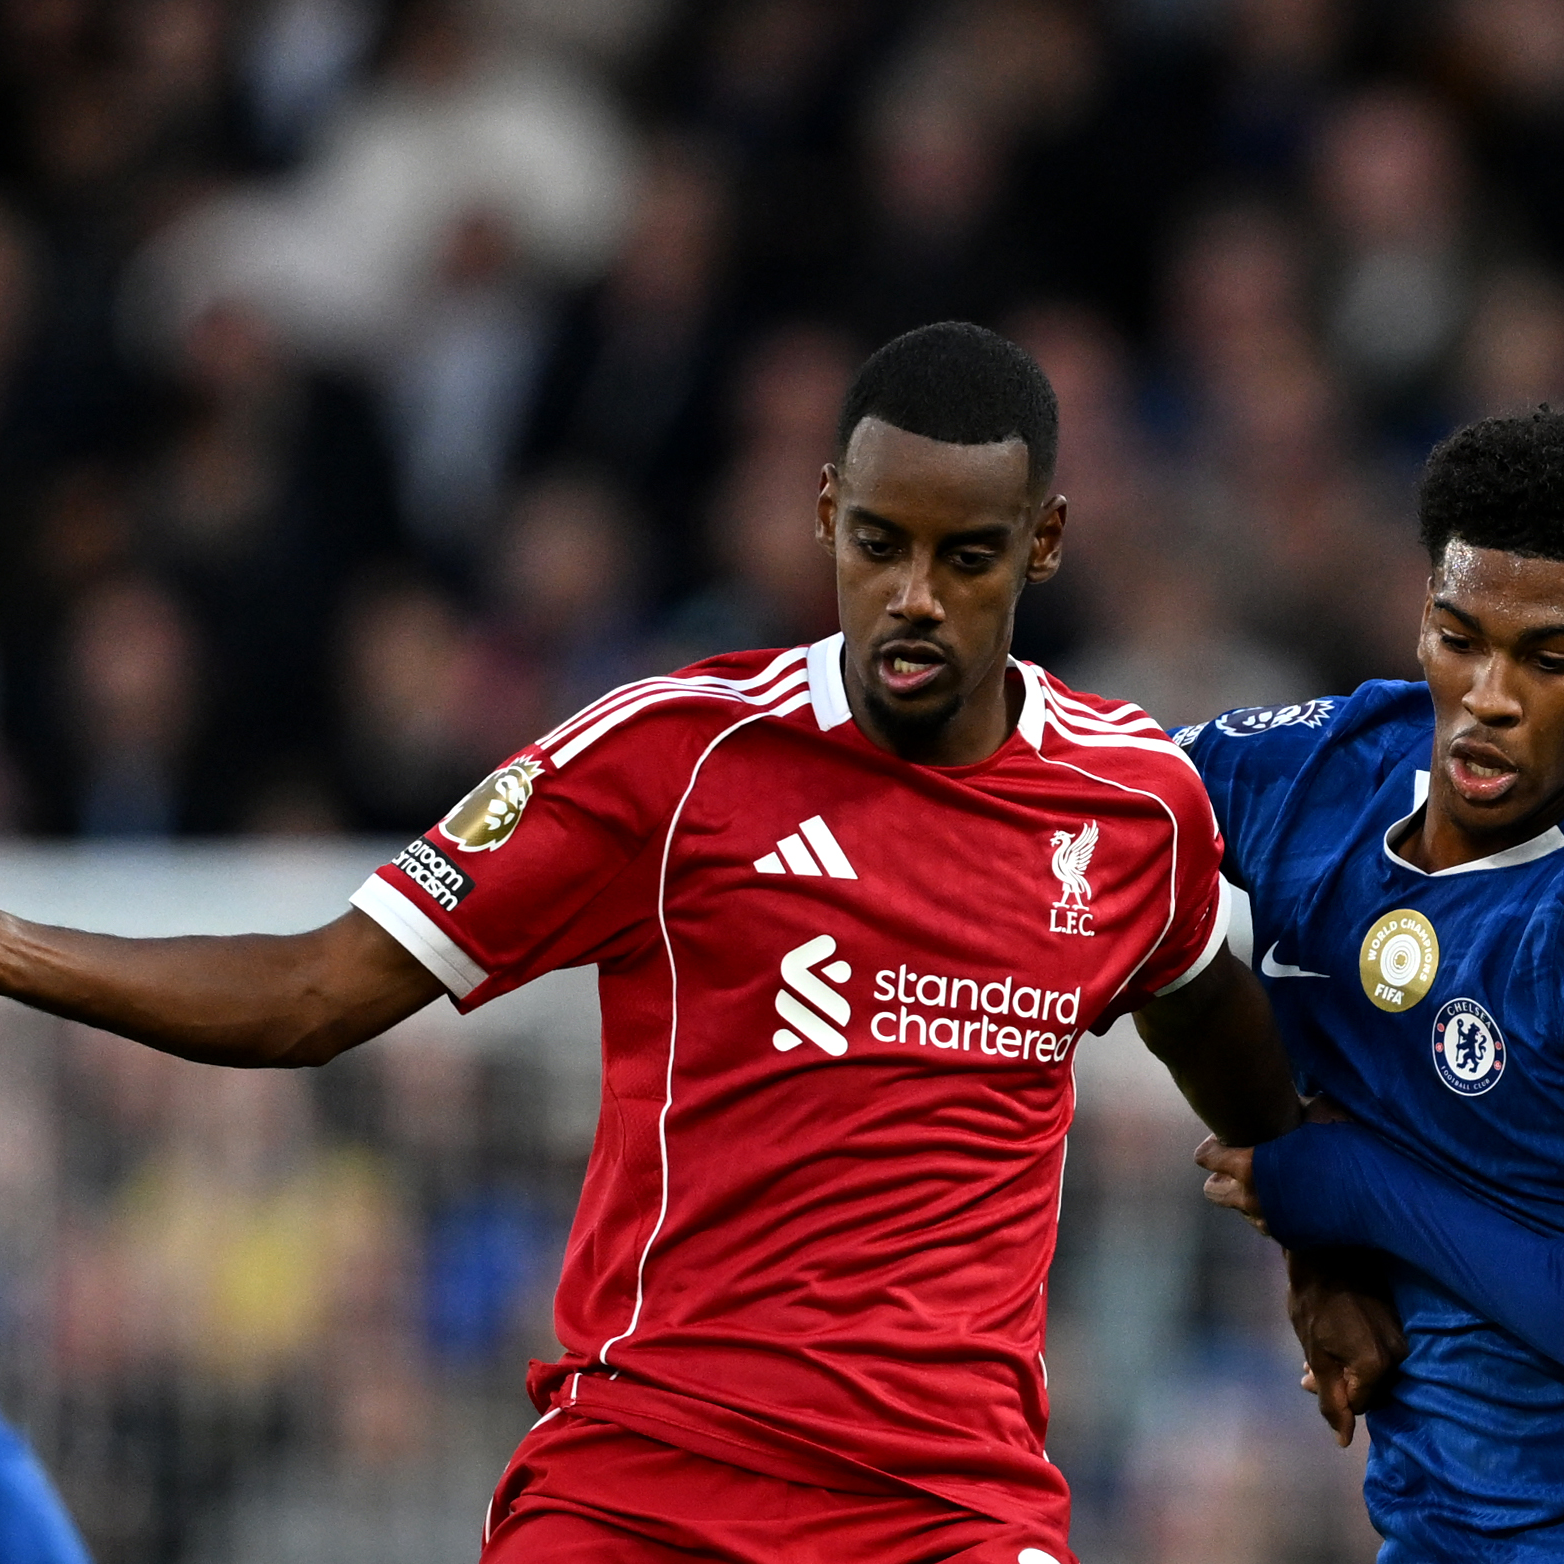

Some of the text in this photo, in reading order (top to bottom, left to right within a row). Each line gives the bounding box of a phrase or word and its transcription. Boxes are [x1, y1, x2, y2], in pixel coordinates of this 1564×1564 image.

[400, 857, 459, 912] racism
[414, 843, 464, 892] room
[1049, 909, 1095, 936] L.F.C.
[1367, 918, 1433, 982] WORLD CHAMPIONS
[873, 963, 1081, 1025] standard
[1374, 983, 1404, 1005] FIFA
[1446, 1001, 1492, 1029] CHELSEA
[870, 1005, 1079, 1063] chartered
[1441, 1065, 1491, 1091] FOOTBALL CLUB
